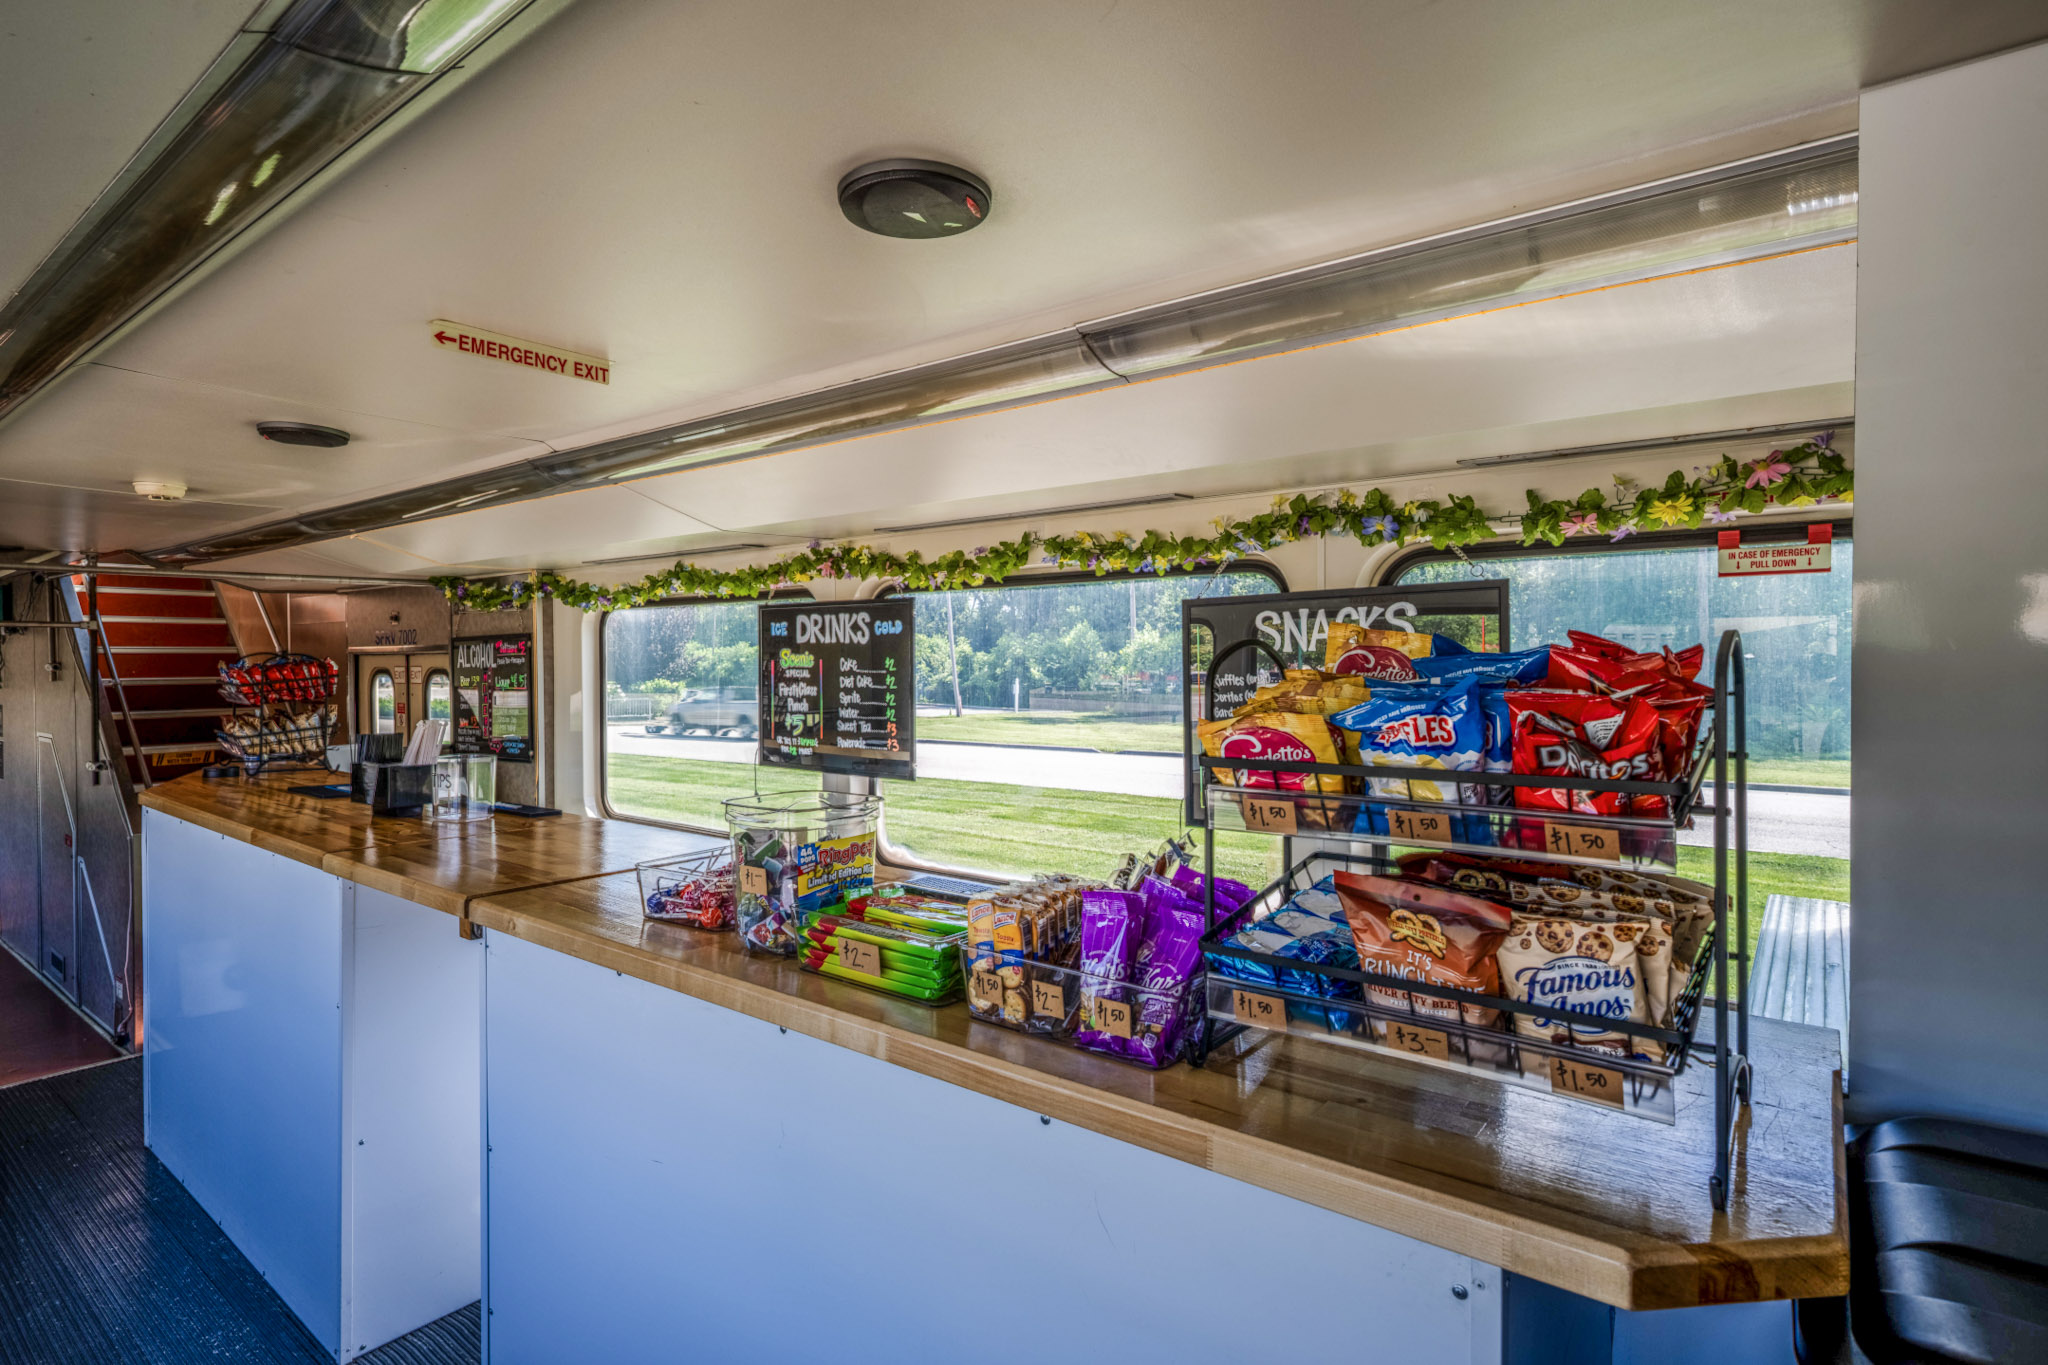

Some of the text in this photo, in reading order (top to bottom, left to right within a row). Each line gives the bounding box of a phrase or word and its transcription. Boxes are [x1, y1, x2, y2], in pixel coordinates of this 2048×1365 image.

[458, 334, 608, 383] EMERGENCY EXIT
[1728, 547, 1820, 560] IN CASE OF EMERGENCY
[1750, 559, 1796, 568] PULL DOWN
[770, 612, 903, 644] ICE DRINKS COLD
[457, 643, 497, 669] ALCOHOL
[780, 648, 814, 669] Scenic
[840, 656, 896, 672] Coke $2
[1333, 650, 1414, 680] Gdetto's
[785, 669, 811, 678] SPECIAL
[839, 674, 897, 689] Diet Coke $2
[787, 697, 809, 712] Punch
[839, 690, 896, 707] Sprite $2
[785, 712, 805, 736] $5
[838, 707, 896, 722] Water $2
[836, 720, 897, 737] Sweet Tea $3
[836, 736, 899, 752] Powerade $3
[432, 773, 452, 789] TIPS
[1249, 801, 1286, 827] $1.50
[1395, 814, 1438, 839] $1.50
[1551, 825, 1605, 856] $1.50
[800, 847, 813, 857] 44
[838, 867, 862, 879] Edition
[972, 906, 990, 918] Lance
[994, 914, 1014, 925] Lance
[1359, 954, 1425, 984] RUNCH
[1407, 950, 1432, 970] IT'S
[976, 974, 998, 994] $1.50
[1515, 966, 1635, 1004] Famous
[1238, 992, 1272, 1018] $1.50
[1368, 984, 1398, 999] RIVER
[1402, 991, 1427, 1006] CTY
[1098, 1001, 1124, 1027] $1.50
[1538, 996, 1624, 1025] Amos
[1556, 1060, 1607, 1091] $1.50
